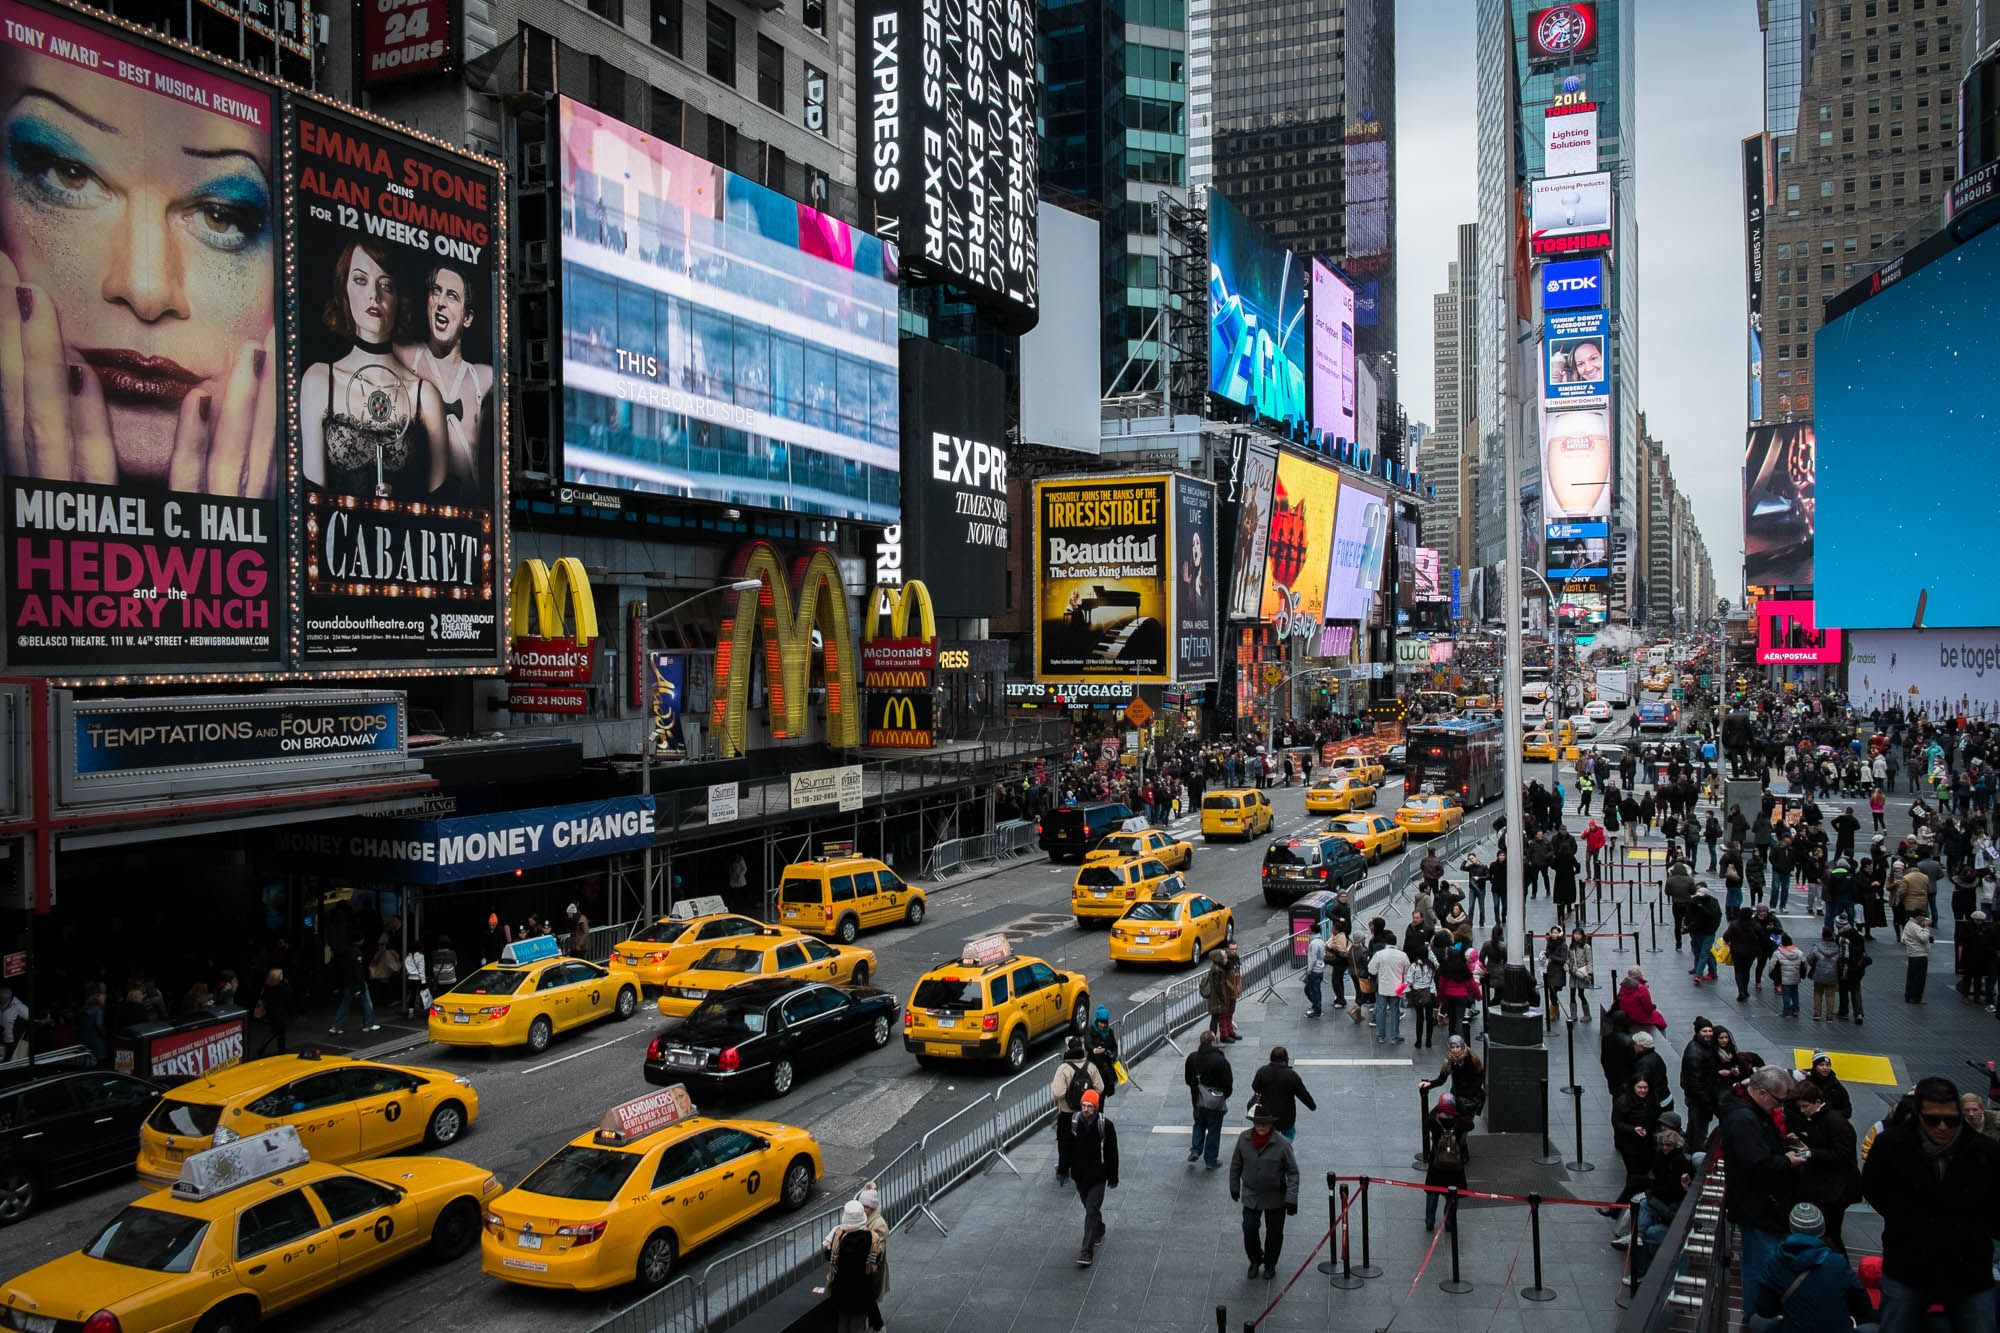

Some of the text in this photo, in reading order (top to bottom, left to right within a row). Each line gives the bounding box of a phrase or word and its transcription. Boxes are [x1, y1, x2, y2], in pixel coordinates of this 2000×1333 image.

[384, 8, 429, 44] 24
[372, 40, 443, 71] HOURS
[5, 20, 261, 124] TONY AWARD BEST MUSICAL REVIVAL
[873, 12, 899, 193] EXPRESS
[1546, 103, 1595, 117] TOSHIBA
[1555, 91, 1586, 106] 2014
[1550, 139, 1591, 150] Solutions
[1552, 129, 1589, 140] Lighting
[300, 119, 487, 211] EMMA STONE
[1008, 69, 1023, 273] EXPRESS
[387, 182, 414, 199] JOINS
[1551, 183, 1575, 193] Lighting
[1576, 181, 1605, 189] Products
[1954, 164, 1998, 194] MARRIOTT
[300, 168, 488, 246] ALAN CUMMING
[924, 127, 943, 265] EXPR
[1955, 182, 1992, 209] MARQUIS
[310, 204, 481, 264] FOR 12 WEEKS ONLY
[1533, 233, 1610, 253] TOSHIBA
[1753, 242, 1761, 282] REUTERS
[1881, 256, 1904, 275] MARRIOTT
[1558, 276, 1597, 291] TDK
[1553, 321, 1586, 329] FACEBOOK
[1577, 314, 1603, 322] DONUTS
[616, 349, 657, 377] THIS
[616, 381, 753, 426] STARBOARD SIDE
[956, 491, 991, 519] TIMES
[1081, 490, 1100, 501] JOINS
[1100, 490, 1112, 500] THE
[1112, 489, 1134, 500] RANKS
[1135, 489, 1144, 499] OF
[1144, 488, 1157, 498] THE
[16, 488, 267, 543] MICHAEL C. HALL
[1189, 509, 1202, 524] LIVE
[966, 521, 993, 547] NOW
[326, 510, 477, 586] CABARET
[1050, 534, 1157, 565] Beautiful
[1611, 532, 1627, 566] CALL
[17, 537, 268, 597] HEDWIG
[1050, 565, 1157, 580] The Carole King Musical
[133, 586, 187, 600] and the
[16, 594, 269, 629] ANGRY INCH
[307, 615, 425, 632] roundabouttheatre.org
[441, 614, 495, 624] ROUNDABOUT
[441, 623, 472, 631] THEATRE
[441, 631, 481, 639] COMPANY
[29, 635, 68, 647] BELASCO
[70, 635, 108, 647] THEATRE,
[111, 636, 124, 647] 111
[126, 636, 136, 647] W.
[155, 636, 182, 647] STREET
[190, 636, 269, 647] HEDWIGBROADWAY.COM
[864, 647, 932, 658] McDonald's
[1180, 633, 1211, 661] IF/THEN
[1319, 626, 1353, 657] FOREVER
[510, 652, 588, 667] McDonald's
[1857, 653, 1876, 664] android
[1940, 642, 1958, 668] be
[520, 669, 574, 678] Restaurant
[510, 696, 582, 706] OPEN 24 HOURS
[1058, 684, 1133, 697] LUGGAGE
[87, 714, 387, 749] TEMPTATIONS AND FOUR TOPS
[281, 733, 378, 750] ON BROADWAY
[802, 776, 835, 789] Summit
[349, 834, 435, 862] CHANGE
[439, 809, 655, 866] MONEY CHANGE
[207, 1033, 243, 1068] BOYS
[619, 1091, 673, 1120] FLASHDANCERS
[623, 1103, 675, 1130] GENTLEMEN'S CLUB
